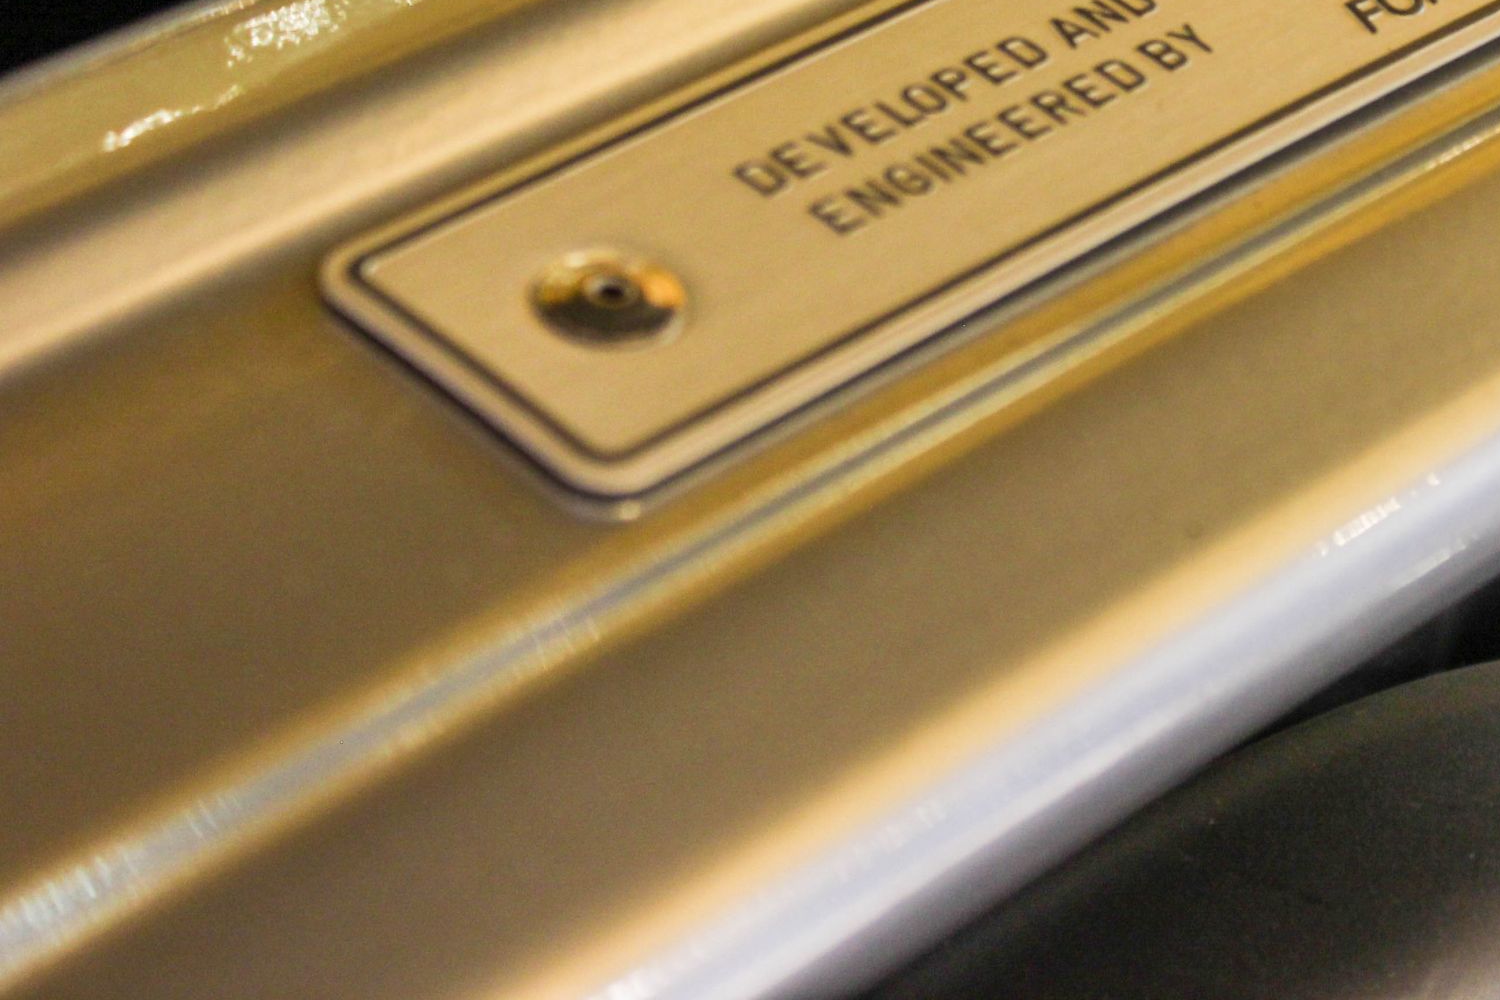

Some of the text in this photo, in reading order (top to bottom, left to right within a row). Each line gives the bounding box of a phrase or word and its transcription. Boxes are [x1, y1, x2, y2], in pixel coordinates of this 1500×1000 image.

[732, 34, 1049, 198] DEVELOPED
[807, 22, 1214, 236] ENGINEERED BY
